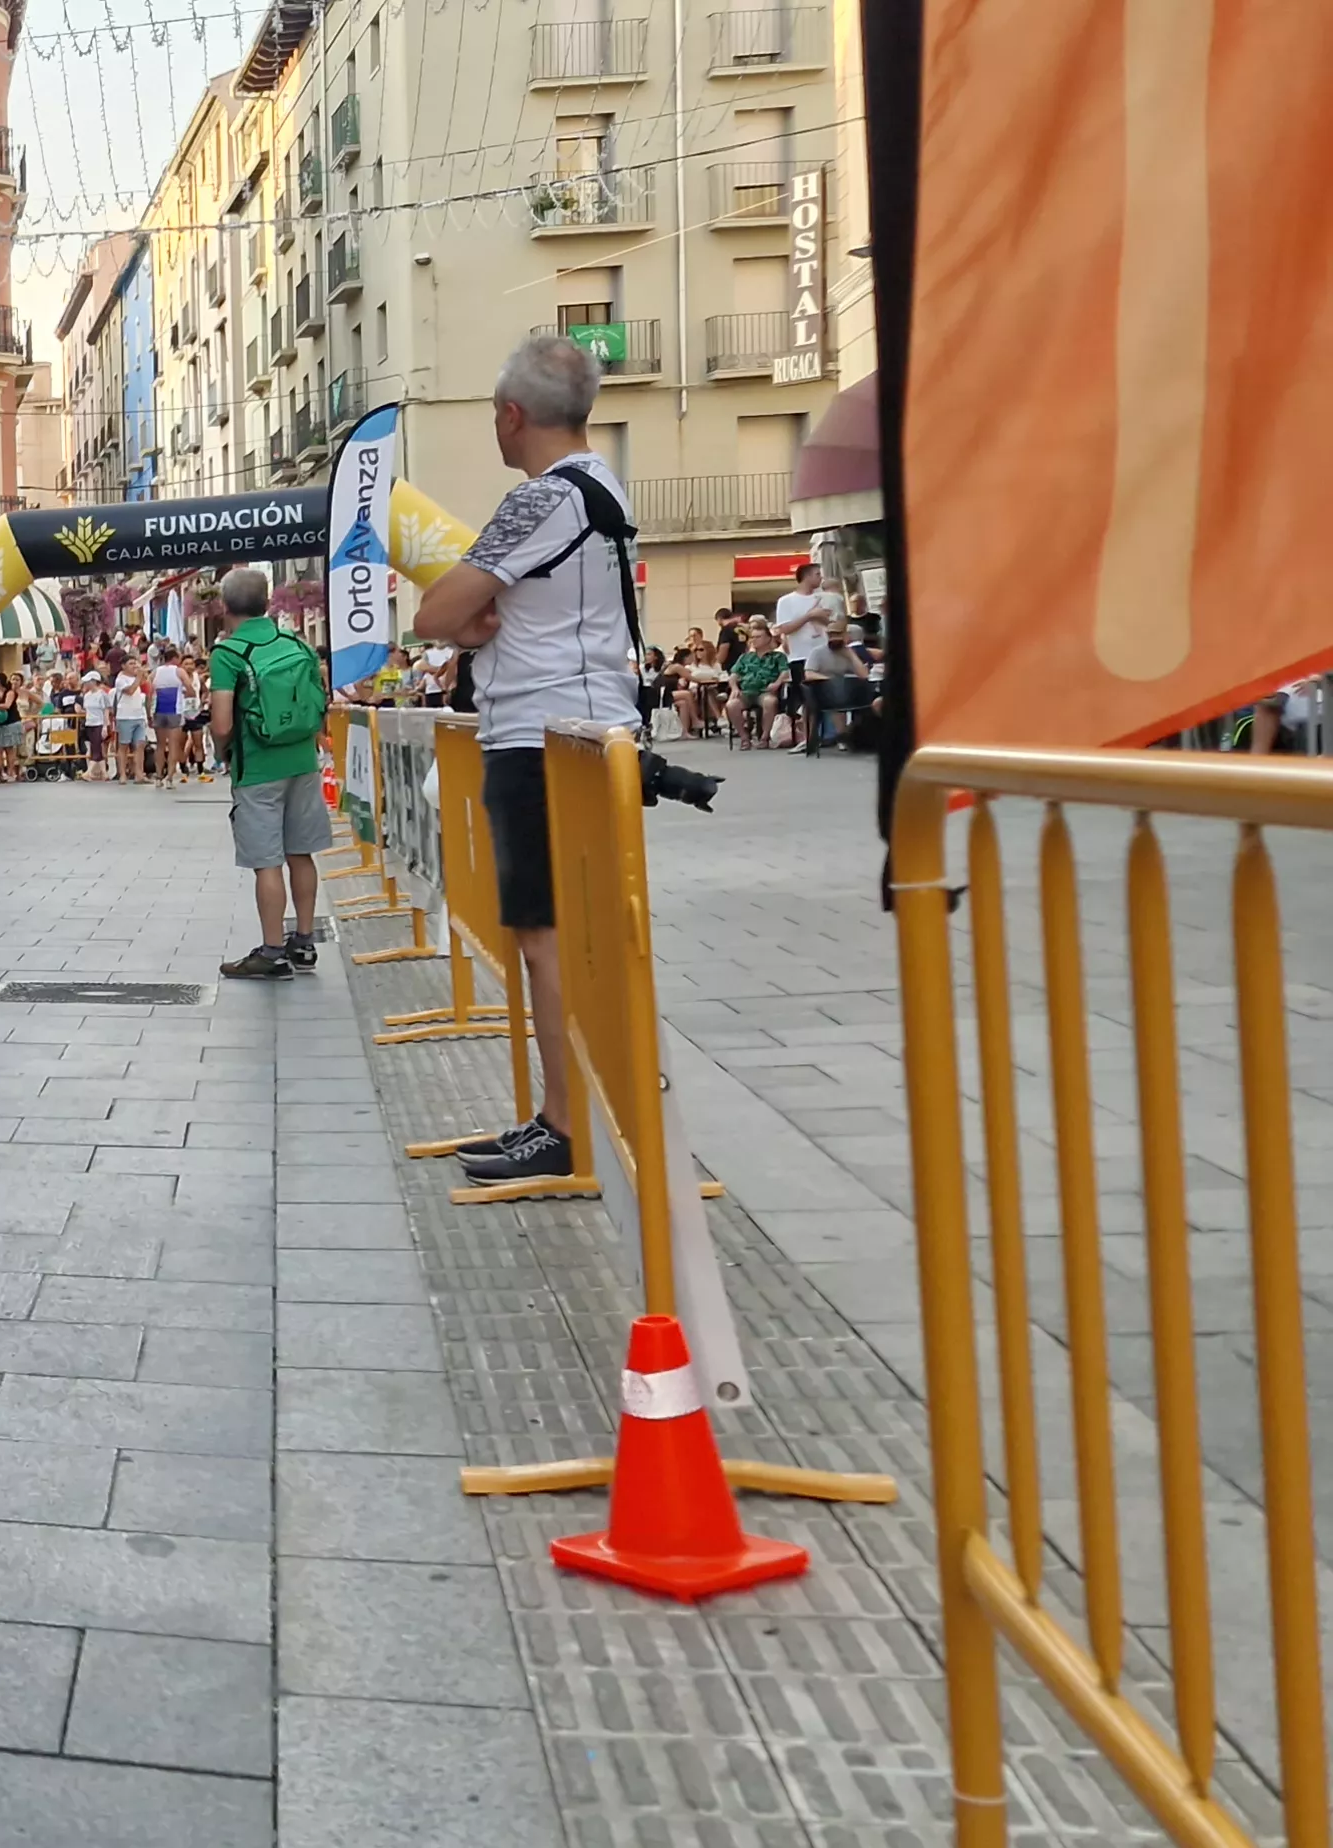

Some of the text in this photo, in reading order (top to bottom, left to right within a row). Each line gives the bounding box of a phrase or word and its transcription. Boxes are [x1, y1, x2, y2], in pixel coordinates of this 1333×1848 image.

[791, 172, 819, 347] HOSTAL
[773, 352, 821, 384] RUGACA
[144, 501, 303, 538] FUNDACIÓN
[106, 546, 154, 561] CAJA
[161, 540, 223, 557] RURAL
[231, 537, 255, 550] DE
[345, 447, 380, 634] OrtoAvanza
